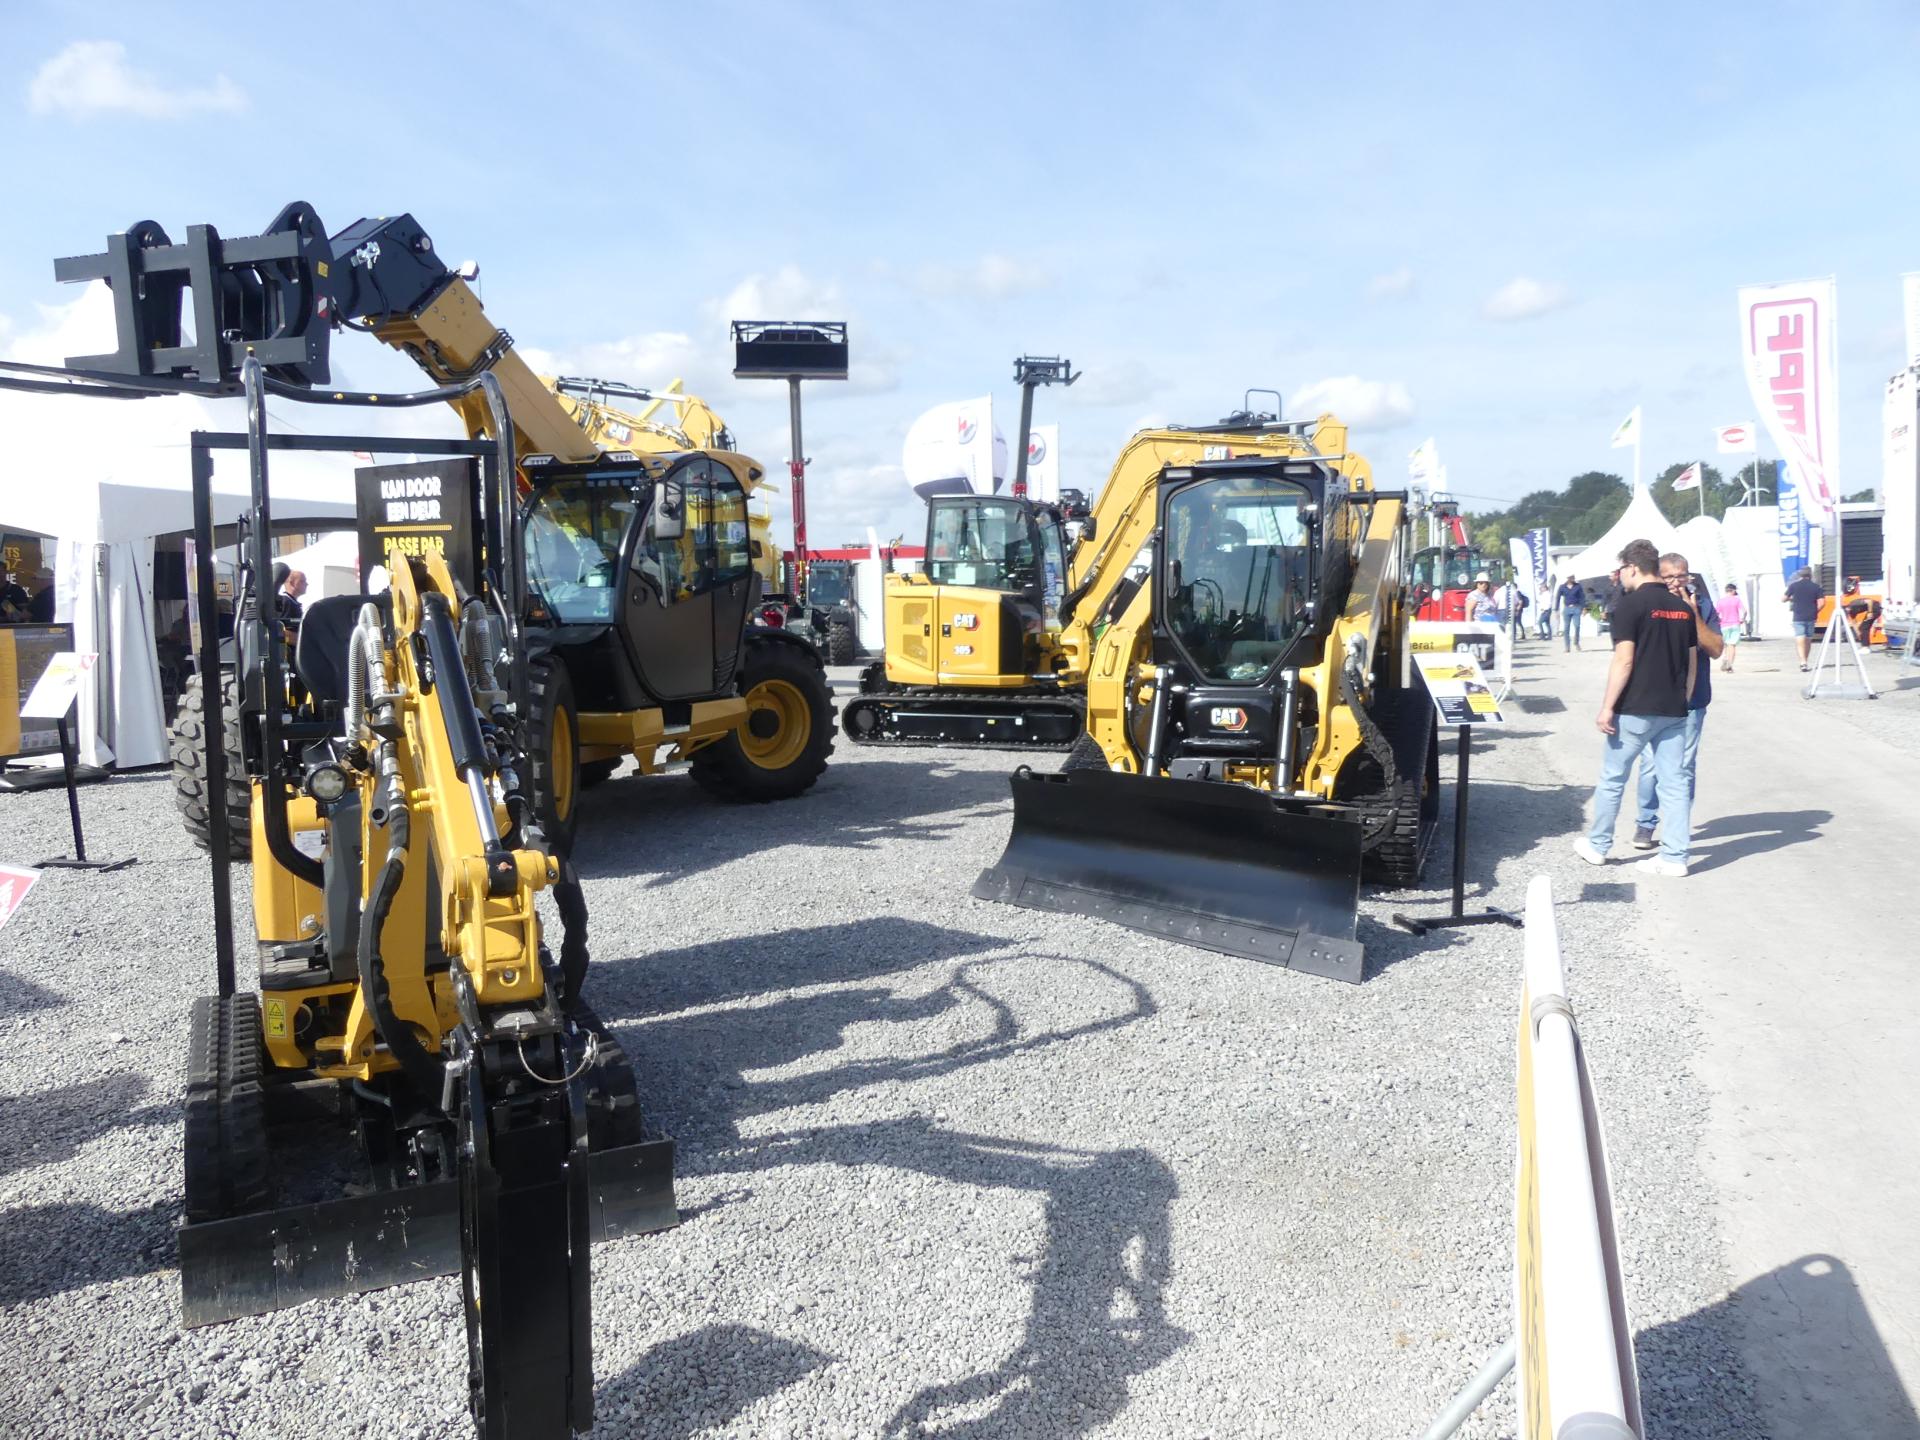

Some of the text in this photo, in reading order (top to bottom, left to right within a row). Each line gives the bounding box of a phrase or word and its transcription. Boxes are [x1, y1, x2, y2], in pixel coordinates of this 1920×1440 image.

[607, 422, 631, 442] CAT
[1204, 446, 1228, 461] CAT
[381, 476, 441, 499] KAN DOOR
[387, 499, 441, 522] EEN DEUR
[1778, 487, 1799, 559] TUCHEL
[384, 536, 444, 556] PASSE PAR
[953, 613, 977, 629] CAT
[1456, 643, 1492, 662] CAT
[1211, 707, 1239, 726] CAT
